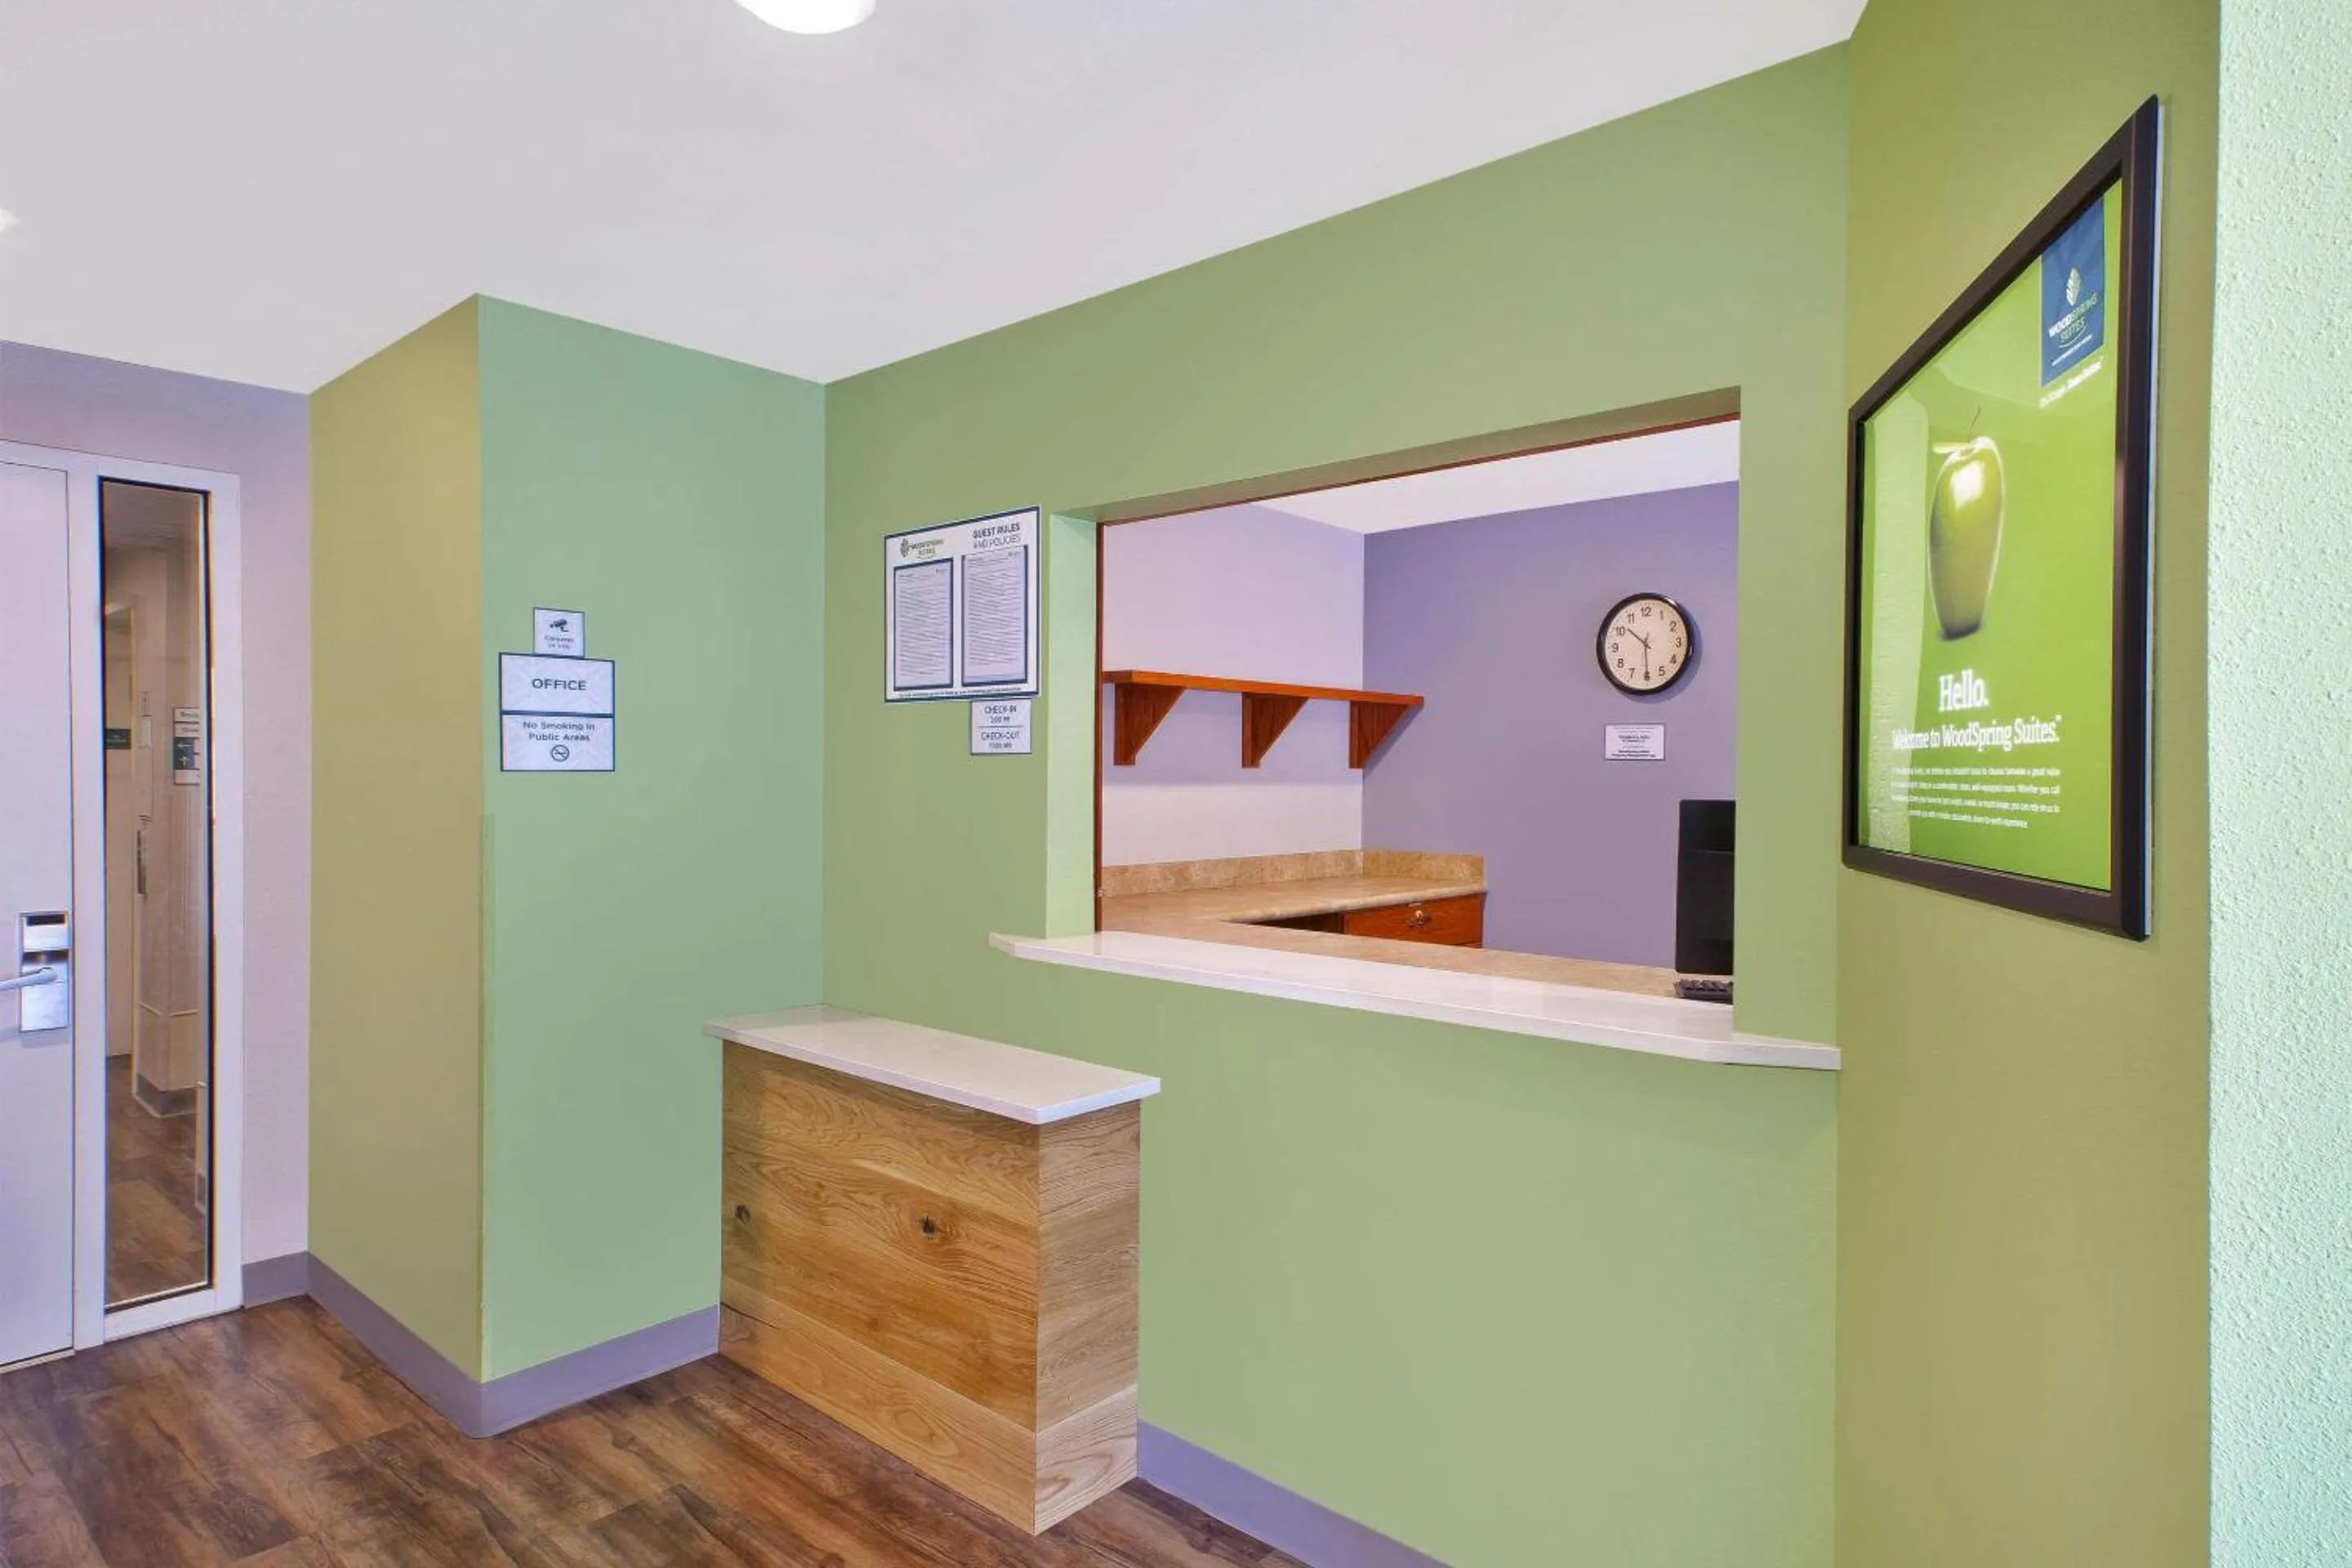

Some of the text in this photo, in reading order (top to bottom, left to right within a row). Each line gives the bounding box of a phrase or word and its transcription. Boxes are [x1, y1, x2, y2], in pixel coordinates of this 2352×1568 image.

[2059, 316, 2085, 344] SUITES
[1627, 612, 1635, 623] 11
[1641, 607, 1652, 617] 12
[1659, 609, 1664, 621] 1
[1616, 626, 1626, 636] 10
[1669, 621, 1677, 632] 2
[1611, 642, 1619, 653] 9
[1675, 637, 1682, 648] 3
[1617, 657, 1624, 669] 8
[1669, 653, 1677, 664] 4
[1628, 667, 1636, 679] 7
[1659, 666, 1666, 677] 5
[532, 678, 587, 691] OFFICE
[1938, 668, 1989, 712] Hello.
[523, 721, 538, 729] No
[541, 721, 584, 731] Smoking
[528, 733, 590, 742] Public Areas
[1891, 726, 1929, 750] Welcome
[1930, 728, 1940, 748] to
[1941, 719, 2013, 752] WoodSpring
